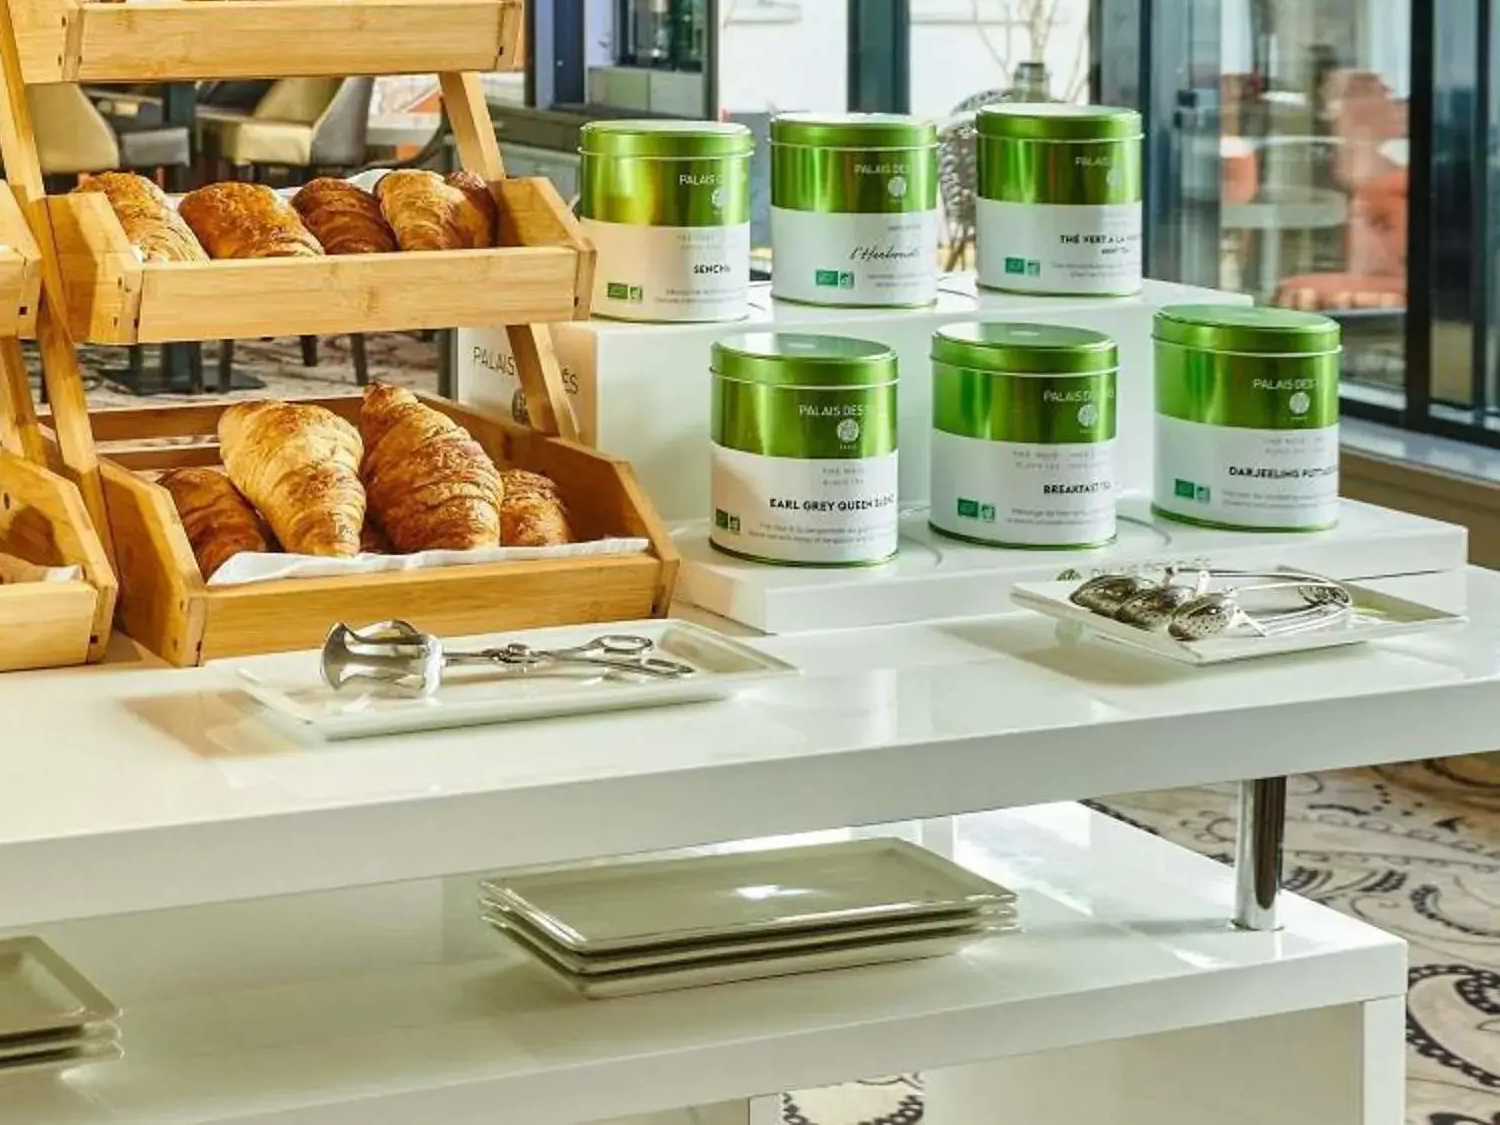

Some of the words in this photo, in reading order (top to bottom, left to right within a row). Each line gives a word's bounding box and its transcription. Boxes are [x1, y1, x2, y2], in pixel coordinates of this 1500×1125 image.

[472, 346, 516, 376] PALAIS
[1252, 378, 1293, 390] PALAIS
[1043, 389, 1083, 402] PALAIS
[799, 404, 841, 416] PALAIS
[843, 404, 864, 416] DES
[769, 498, 800, 510] EARL
[802, 500, 834, 512] GREY
